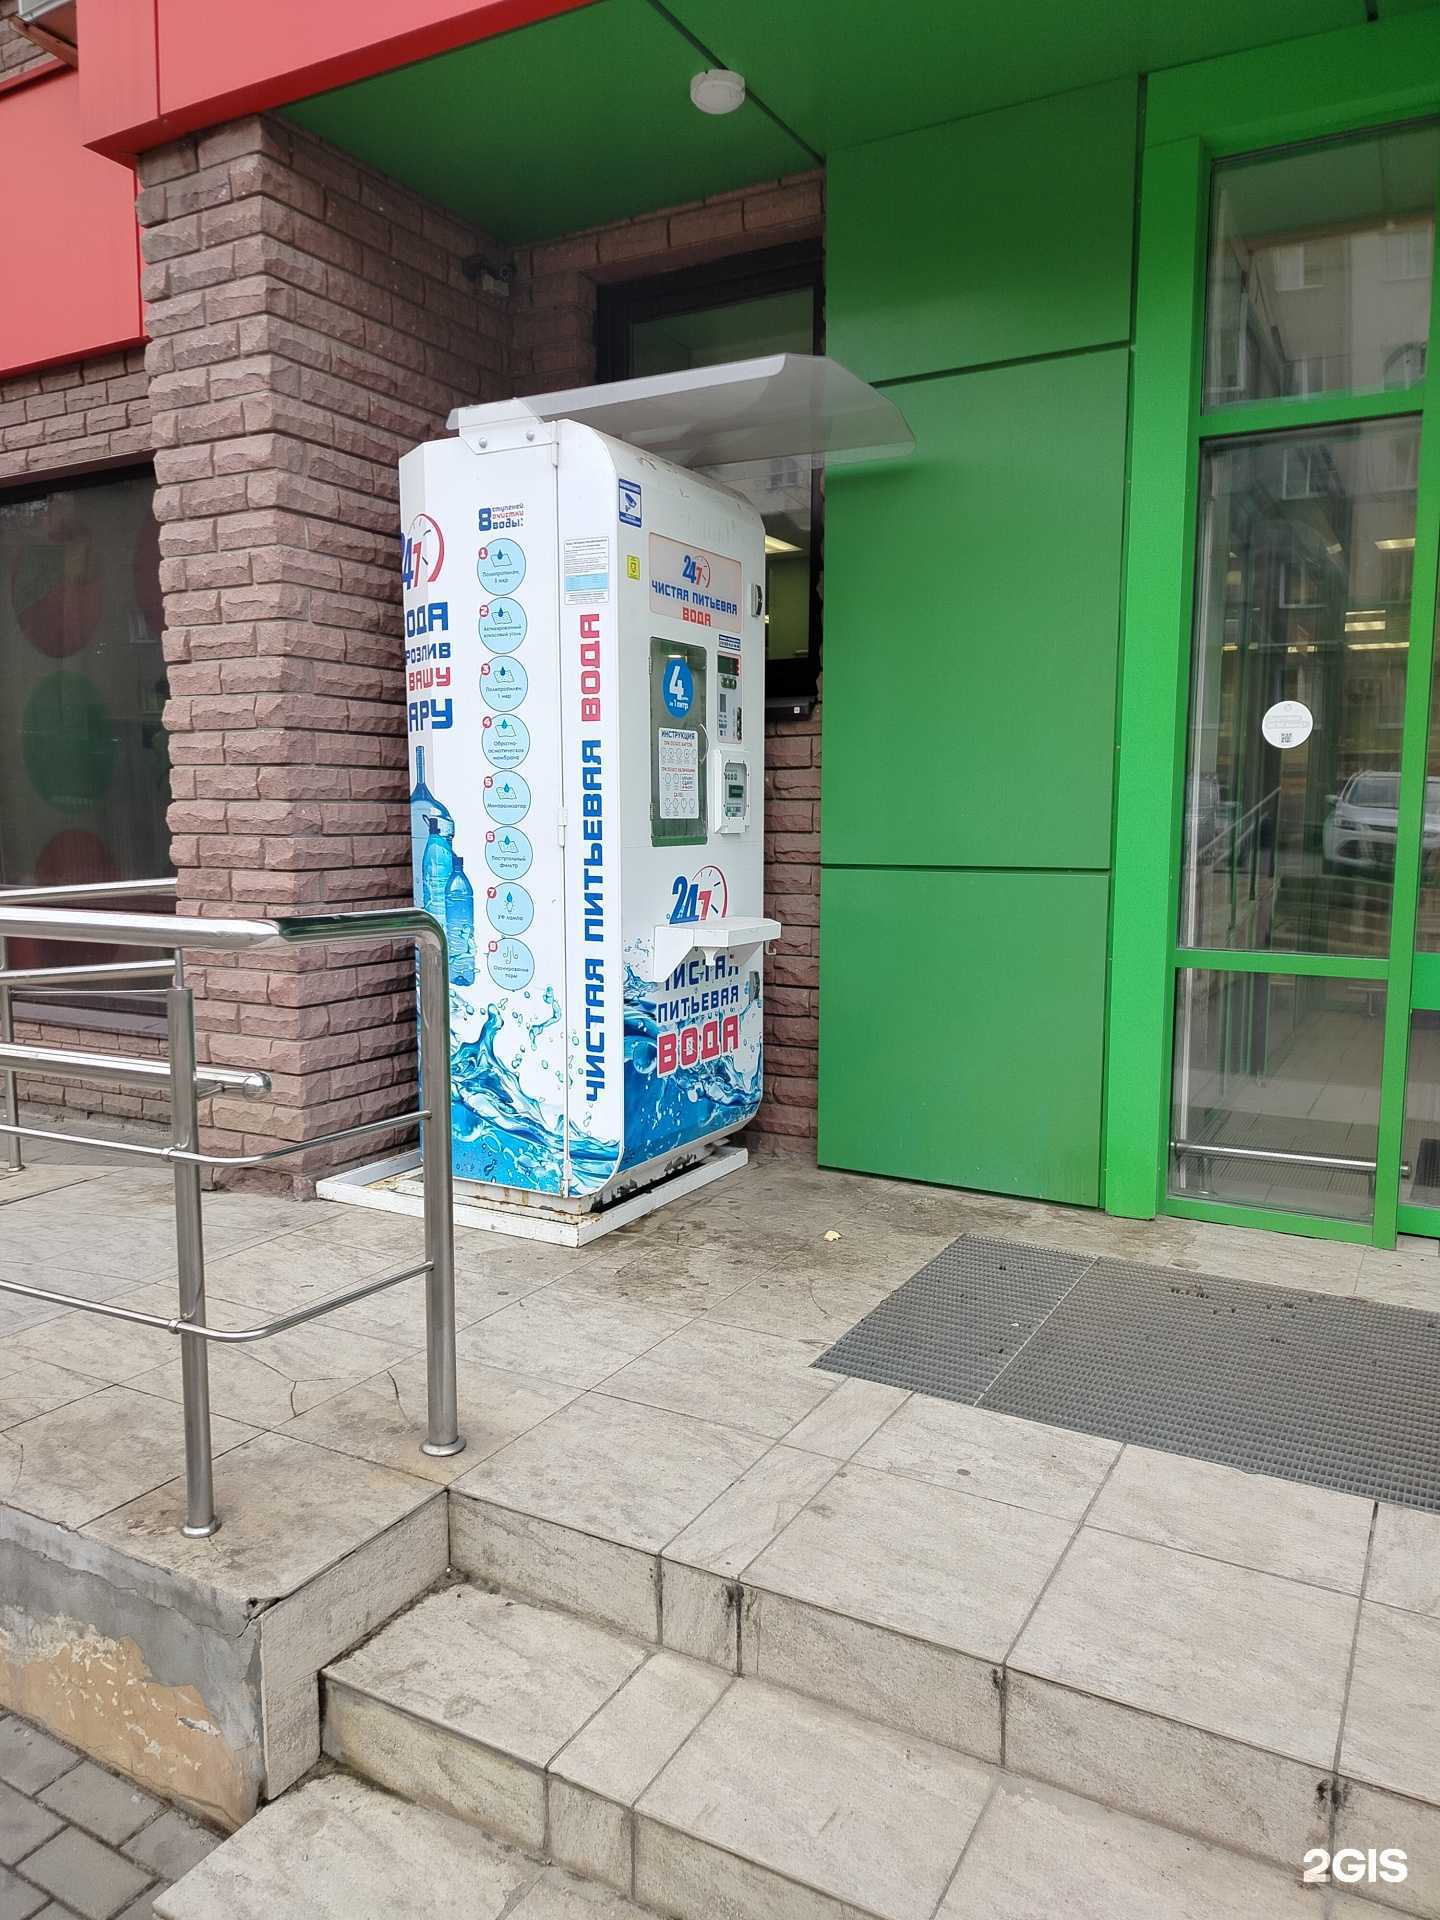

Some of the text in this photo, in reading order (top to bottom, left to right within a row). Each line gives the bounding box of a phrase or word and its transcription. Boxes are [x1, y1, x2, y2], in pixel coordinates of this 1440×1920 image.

[479, 508, 491, 531] 8
[492, 517, 524, 530] воды:
[651, 580, 738, 616] ЧИСТАЯ ПИТЬЕВАЯ
[682, 607, 711, 627] ВОДА
[405, 642, 450, 666] РОЗЛИВ
[581, 614, 600, 721] ВОДА
[408, 667, 450, 691] ВАШУ
[582, 740, 603, 942] ПИТЬЕВАЯ
[669, 875, 712, 924] 247
[658, 985, 739, 1023] ПИТЬЕВАЯ
[585, 959, 605, 1101] ЧИСТАЯ
[659, 1014, 739, 1075] ВОДА
